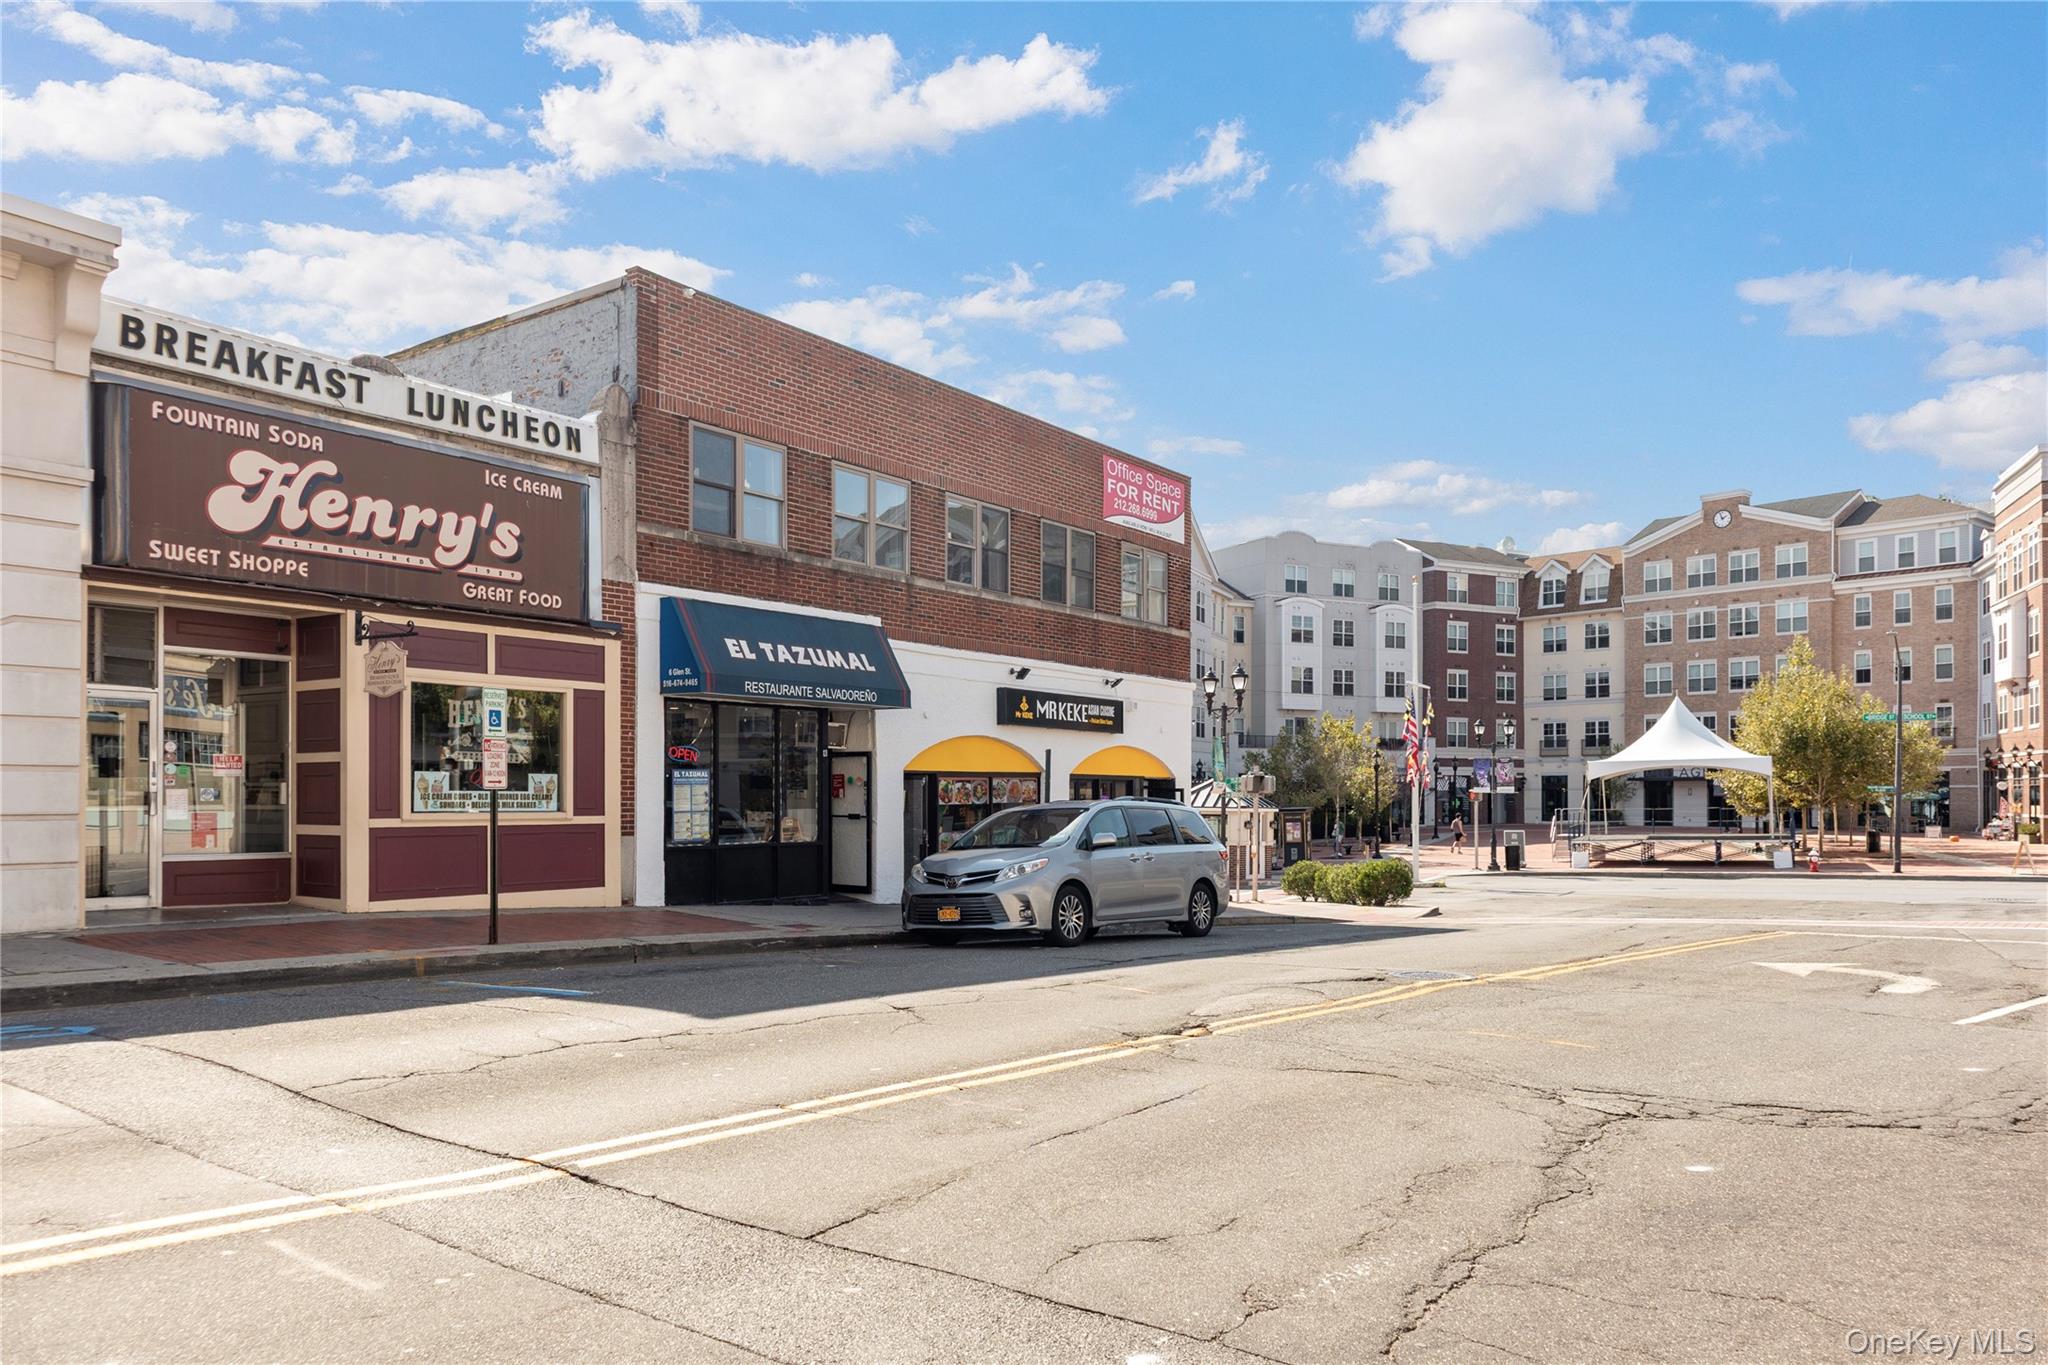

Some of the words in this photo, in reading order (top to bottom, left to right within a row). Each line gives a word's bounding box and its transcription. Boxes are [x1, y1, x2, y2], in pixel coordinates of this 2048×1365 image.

[119, 313, 371, 404] BREAKFAST
[406, 386, 582, 453] LUNCHEON
[151, 400, 260, 440] FOUNTAIN
[267, 425, 324, 452] SODA
[484, 469, 507, 488] ICE
[512, 476, 563, 500] CREAM
[1107, 459, 1143, 485] Office
[1145, 473, 1182, 499] Space
[206, 448, 523, 567] Henry's
[1107, 478, 1139, 503] FOR
[1142, 490, 1180, 516] RENT
[148, 539, 221, 566] SWEET
[228, 550, 310, 578] SHOPPE
[278, 538, 425, 566] ESTABLISHED
[462, 582, 514, 604] GREAT
[519, 590, 562, 609] FOOD
[723, 637, 757, 660] EL
[758, 642, 877, 673] TAZUMAL
[672, 667, 685, 677] Glen
[744, 681, 814, 698] RESTAURANTE
[815, 686, 878, 703] SALVADOREÑO
[1036, 699, 1057, 720] MR
[1058, 702, 1089, 723] KEKE
[667, 746, 699, 762] OPEN
[501, 801, 515, 809] MILK
[516, 801, 537, 809] SHAKES
[520, 793, 530, 801] EGG
